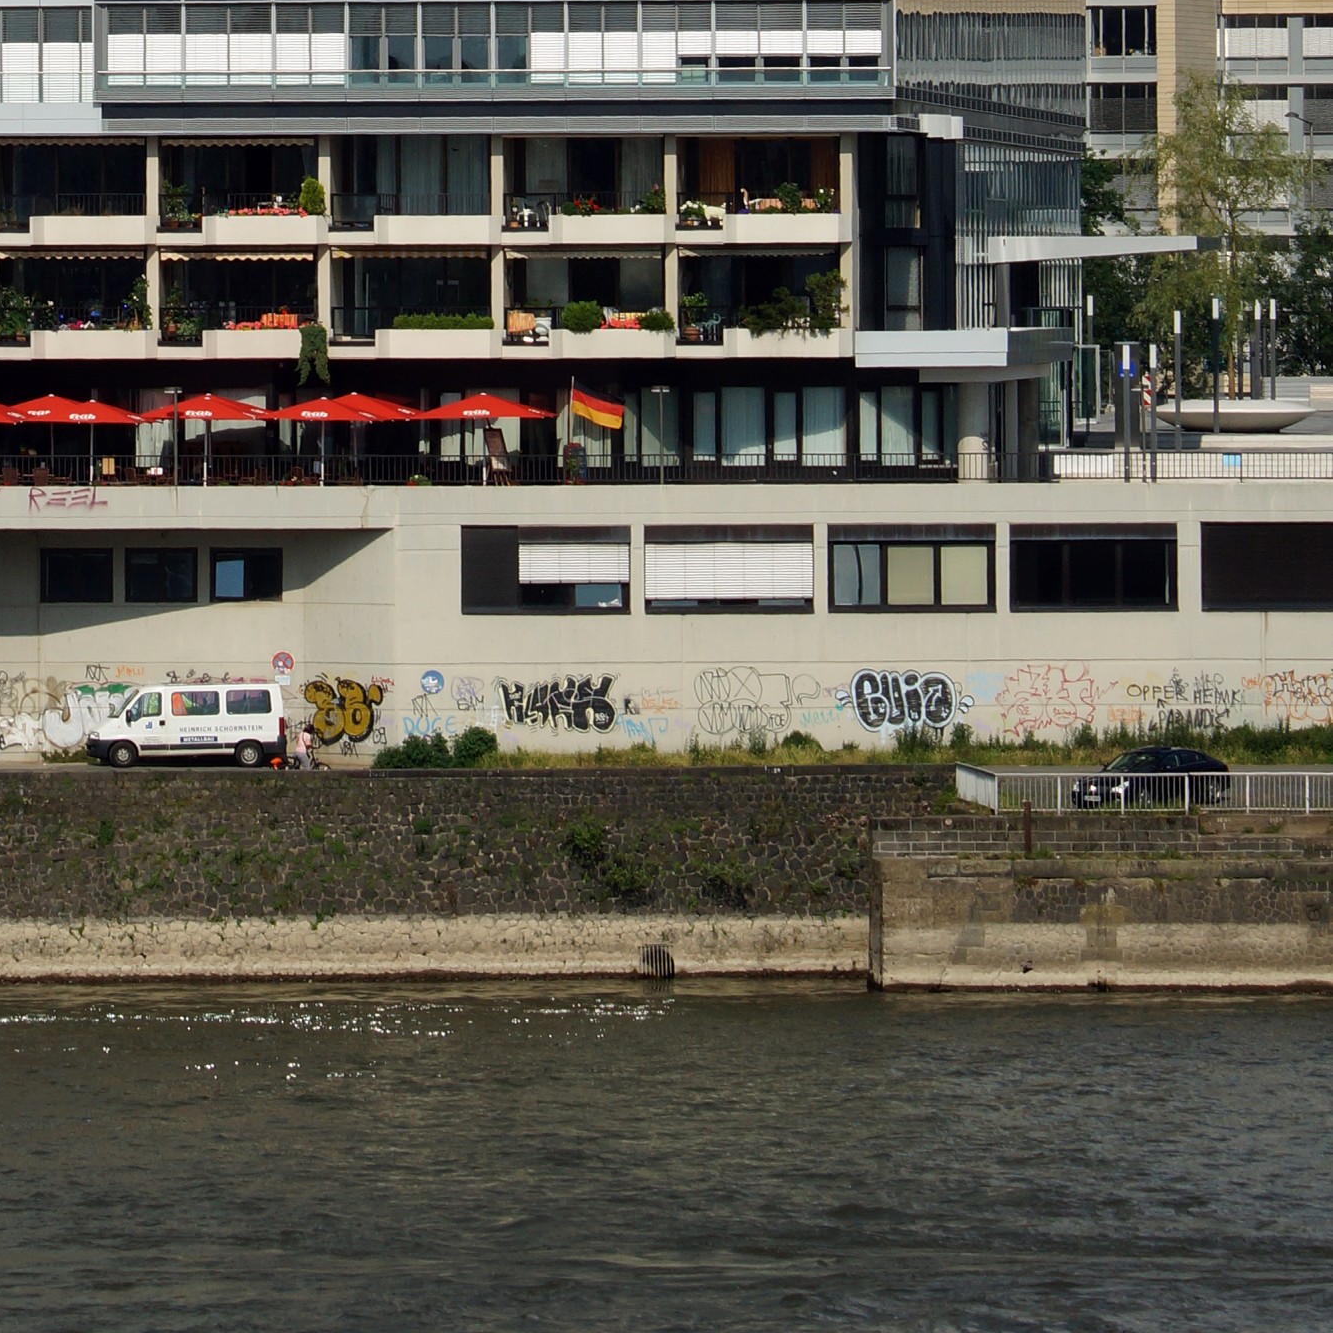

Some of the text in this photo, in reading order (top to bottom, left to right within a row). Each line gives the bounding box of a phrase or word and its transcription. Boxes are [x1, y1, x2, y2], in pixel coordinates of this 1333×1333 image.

[28, 486, 109, 512] REEL
[179, 724, 264, 733] HEINRICH SCHORNSTEIN
